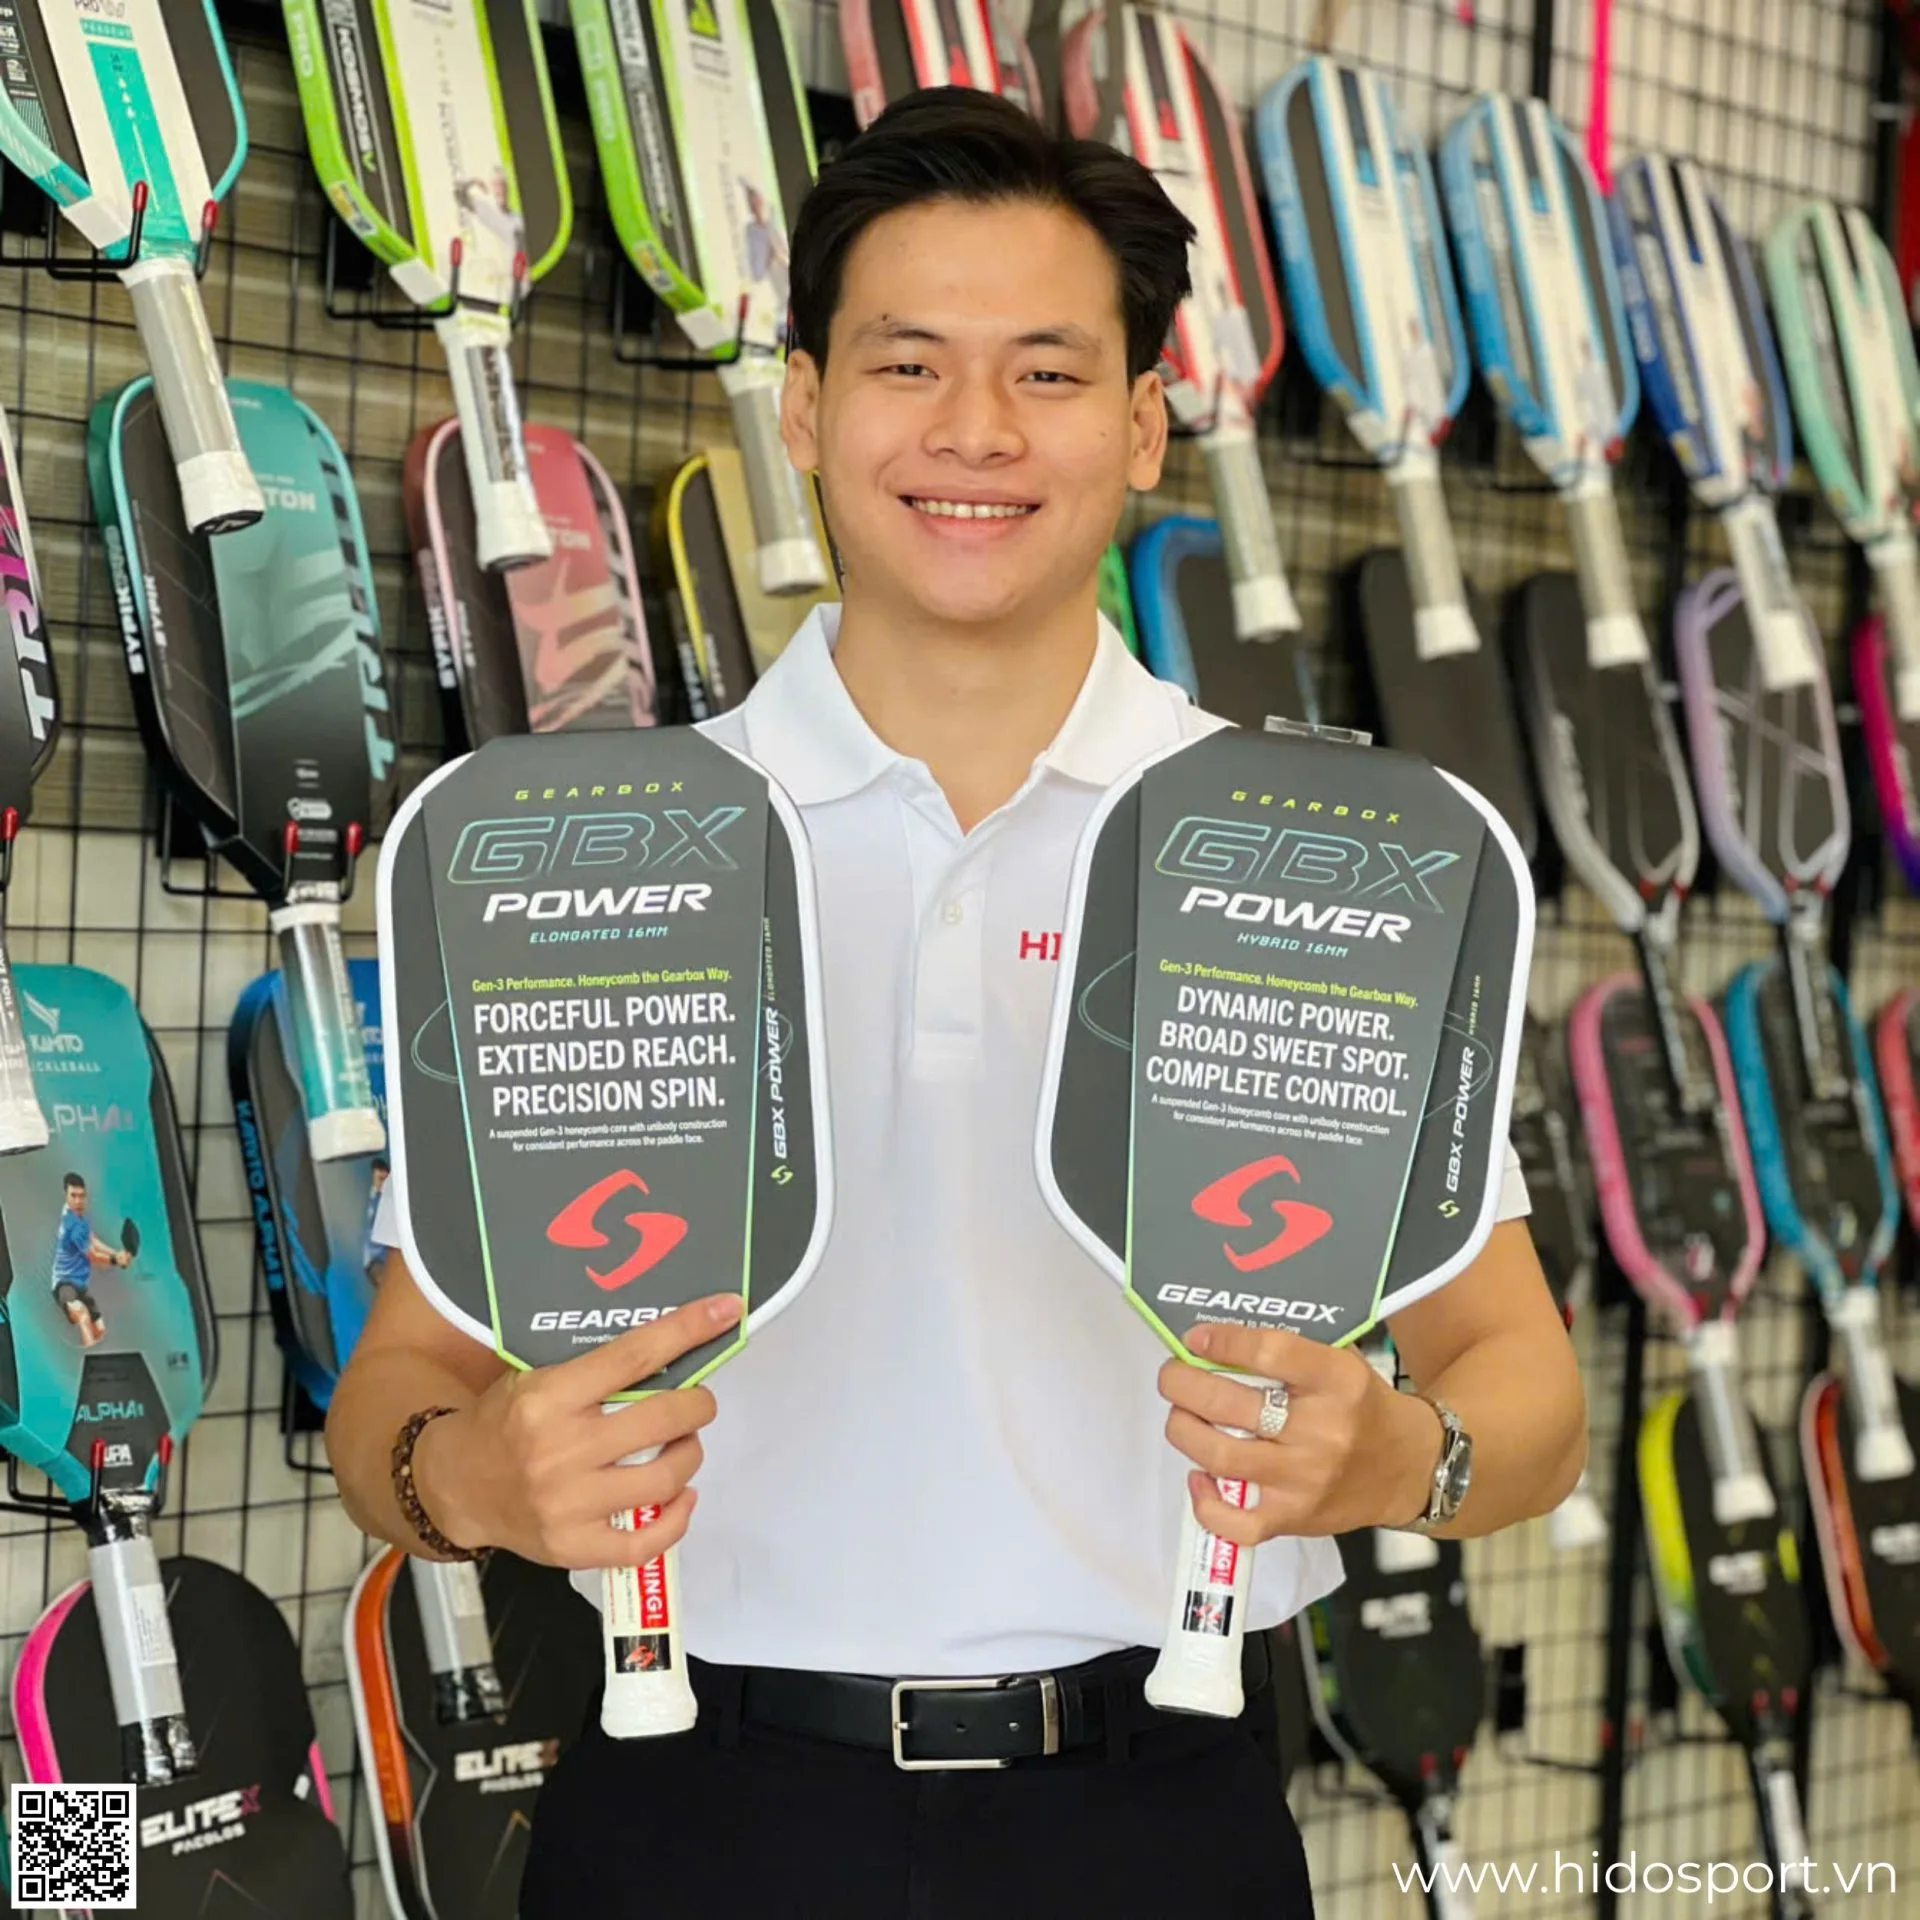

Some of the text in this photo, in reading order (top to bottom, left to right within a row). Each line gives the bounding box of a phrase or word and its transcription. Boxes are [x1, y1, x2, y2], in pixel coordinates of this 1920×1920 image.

[264, 486, 317, 512] TON
[514, 780, 685, 801] GEARBOX
[1230, 789, 1401, 825] GEARBOX
[447, 806, 747, 884] GBX
[1154, 815, 1462, 914] GBX
[482, 883, 713, 922] POWER
[1179, 886, 1412, 943] POWER
[528, 925, 669, 944] ELONGATED 16MM
[1236, 931, 1349, 959] HYBRID 16MM
[472, 967, 732, 993] Gen-3 Performance. Honeycomb the Gearbox Way.
[1159, 958, 1419, 1008] Gen-3 Performance. Honeycomb the Gearbox Way.
[473, 992, 736, 1035] FORCEFUL POWER.
[1177, 985, 1395, 1042] DYNAMIC POWER.
[31, 1061, 102, 1073] ICKLEBALL
[478, 1033, 736, 1077] EXTENDED REACH.
[1159, 1019, 1410, 1081] BROAD SWEET SPOT.
[492, 1076, 725, 1118] PRECISION SPIN.
[765, 1006, 788, 1159] GBX POWER
[1146, 1055, 1408, 1117] COMPLETE CONTROL.
[489, 1118, 728, 1141] A suspended Gen-3 honeycomb core with unibody construction
[1151, 1093, 1391, 1136] A suspended Gen-3 honeycomb core with unibody construction
[1172, 1110, 1365, 1146] for consistent performance across the paddle face.
[1446, 1046, 1475, 1193] GBX POWER
[512, 1132, 704, 1152] for consistent performance across the paddle face.
[530, 1306, 680, 1332] GEARB
[1156, 1282, 1341, 1325] GEARBOX
